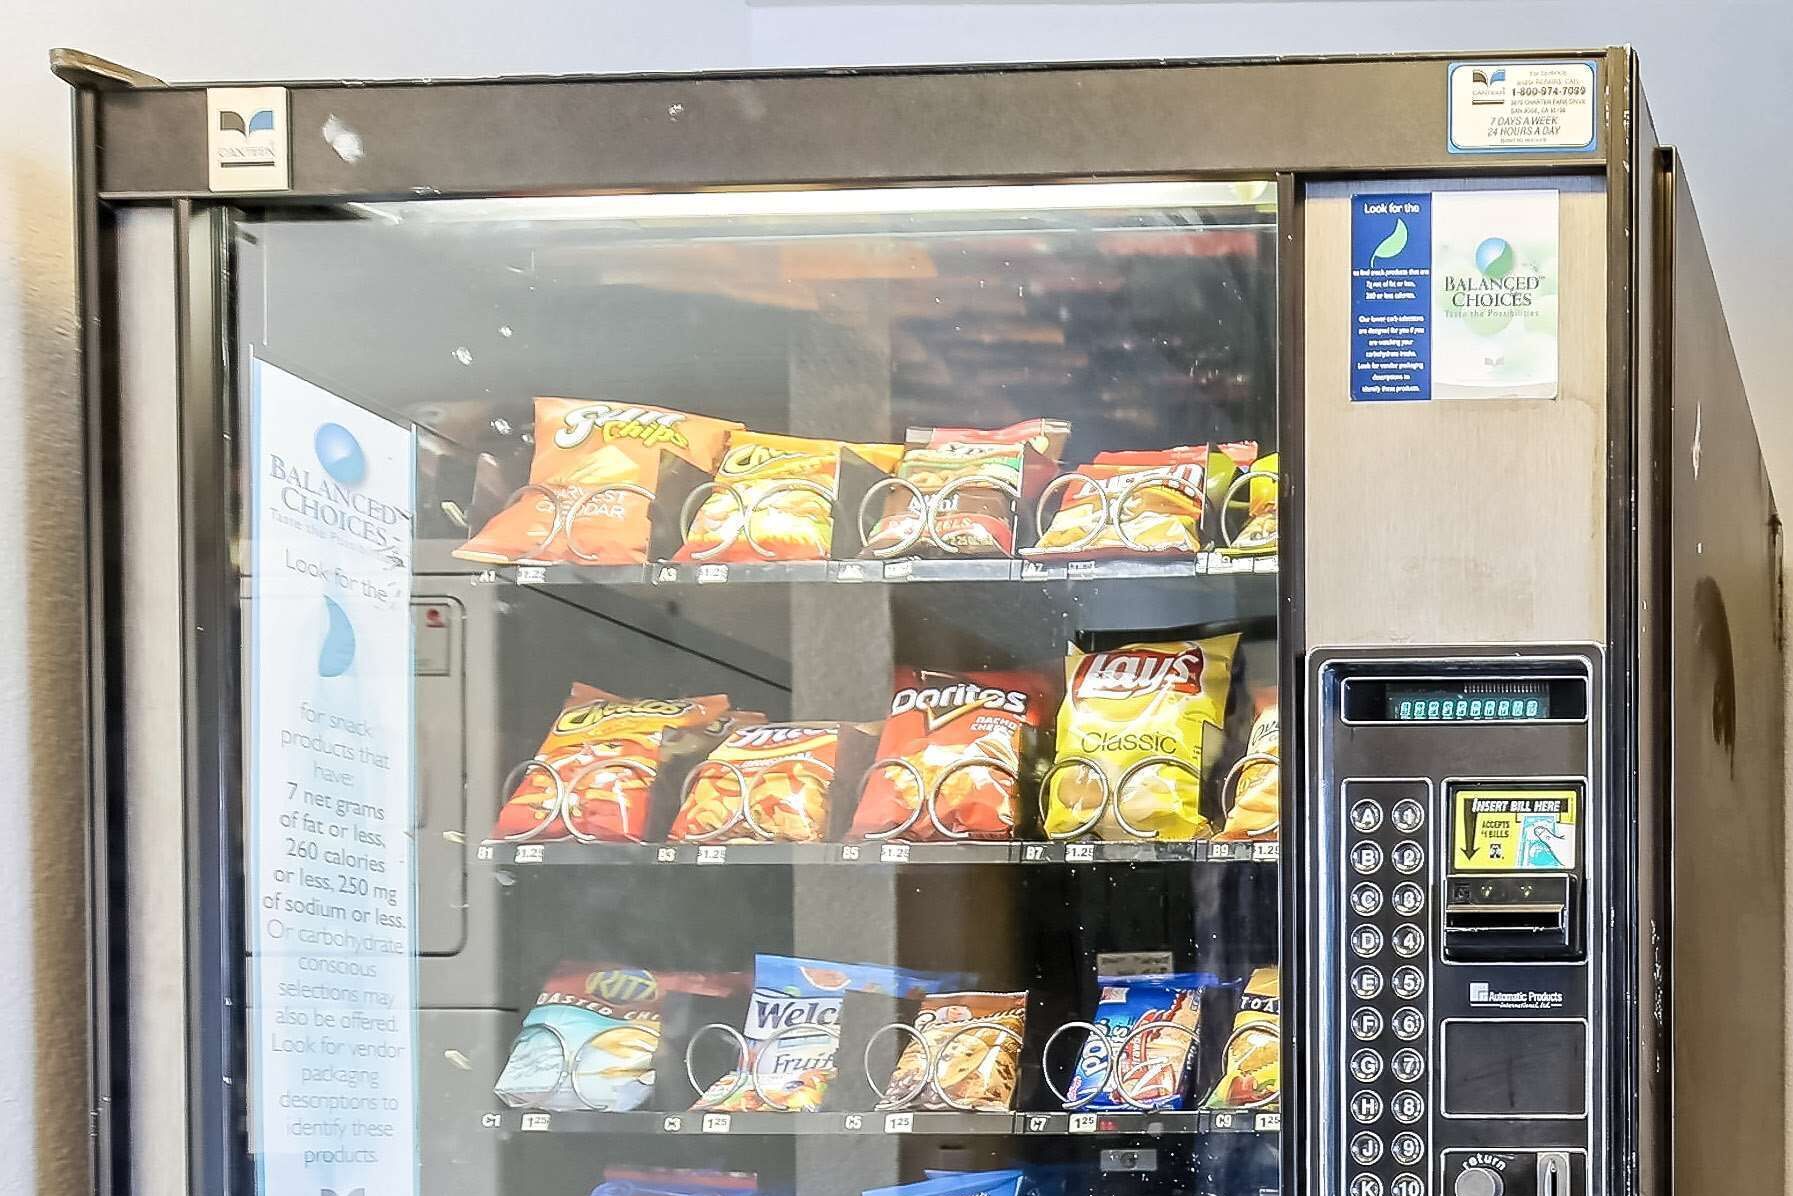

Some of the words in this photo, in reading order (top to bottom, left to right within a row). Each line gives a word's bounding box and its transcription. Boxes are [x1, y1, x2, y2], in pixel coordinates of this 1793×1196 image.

[1497, 117, 1522, 126] DAYS
[1523, 117, 1530, 126] A
[1532, 116, 1558, 126] WEEK
[1488, 128, 1498, 137] 24
[1500, 127, 1533, 136] HOURS
[1542, 126, 1560, 135] DAY
[1364, 203, 1387, 214] Look
[1389, 202, 1403, 214] for
[1404, 203, 1420, 213] the
[1445, 276, 1540, 291] BALANCED
[1452, 292, 1532, 306] CHOICES
[601, 420, 689, 449] Chips
[270, 453, 397, 525] BALANCED
[281, 486, 388, 547] CHOICES
[285, 548, 329, 583] Look
[892, 683, 1028, 715] Doritos
[281, 729, 354, 762] products
[358, 747, 391, 770] that
[1081, 731, 1177, 755] Classic
[287, 781, 298, 800] 7
[303, 790, 332, 809] net
[336, 799, 385, 822] grams
[1472, 798, 1508, 812] INSERT
[1511, 800, 1531, 812] BILL
[1534, 800, 1560, 812] HERE
[279, 810, 299, 829] of
[303, 813, 324, 835] fat
[329, 824, 348, 839] or
[1361, 808, 1377, 827] A
[1482, 821, 1510, 829] ACCEPTS
[1489, 830, 1510, 838] BILLS
[286, 837, 318, 860] 260
[324, 848, 386, 875] calories
[1026, 846, 1043, 860] B7
[1213, 844, 1229, 857] B9
[1361, 850, 1376, 865] B
[1403, 850, 1415, 865] 2
[274, 868, 294, 883] or
[338, 874, 369, 896] 250
[373, 886, 398, 907] mg
[263, 891, 282, 910] of
[285, 896, 346, 920] sodium
[352, 909, 371, 923] or
[1361, 892, 1376, 907] C
[298, 927, 404, 955] carbohydrate
[1361, 933, 1376, 948] D
[1403, 933, 1415, 949] 4
[585, 969, 656, 1002] RITZ
[1361, 975, 1375, 990] E
[1403, 975, 1414, 990] 5
[278, 982, 359, 1001] selections
[1489, 991, 1527, 1002] Automatic
[1529, 991, 1562, 1002] Products
[536, 992, 613, 1016] OASTED
[1240, 996, 1280, 1014] TOA
[275, 1006, 308, 1026] also
[314, 1007, 337, 1028] be
[756, 1000, 840, 1029] Welc
[1362, 1016, 1375, 1031] F
[1403, 1016, 1415, 1032] 6
[271, 1032, 317, 1054] Look
[320, 1035, 344, 1056] for
[351, 1042, 406, 1058] vendor
[1361, 1057, 1376, 1074] G
[1403, 1057, 1414, 1074] 7
[301, 1066, 379, 1089] packaging
[383, 1096, 399, 1111] to
[1361, 1099, 1376, 1115] H
[1403, 1098, 1415, 1115] 8
[287, 1117, 347, 1139] identify
[352, 1119, 393, 1137] these
[1030, 1117, 1047, 1132] C7
[1216, 1114, 1231, 1128] C9
[1362, 1140, 1372, 1156] J
[1403, 1139, 1414, 1156] 9
[1461, 1153, 1507, 1171] return
[1361, 1181, 1375, 1196] K
[1399, 1181, 1418, 1196] 10
